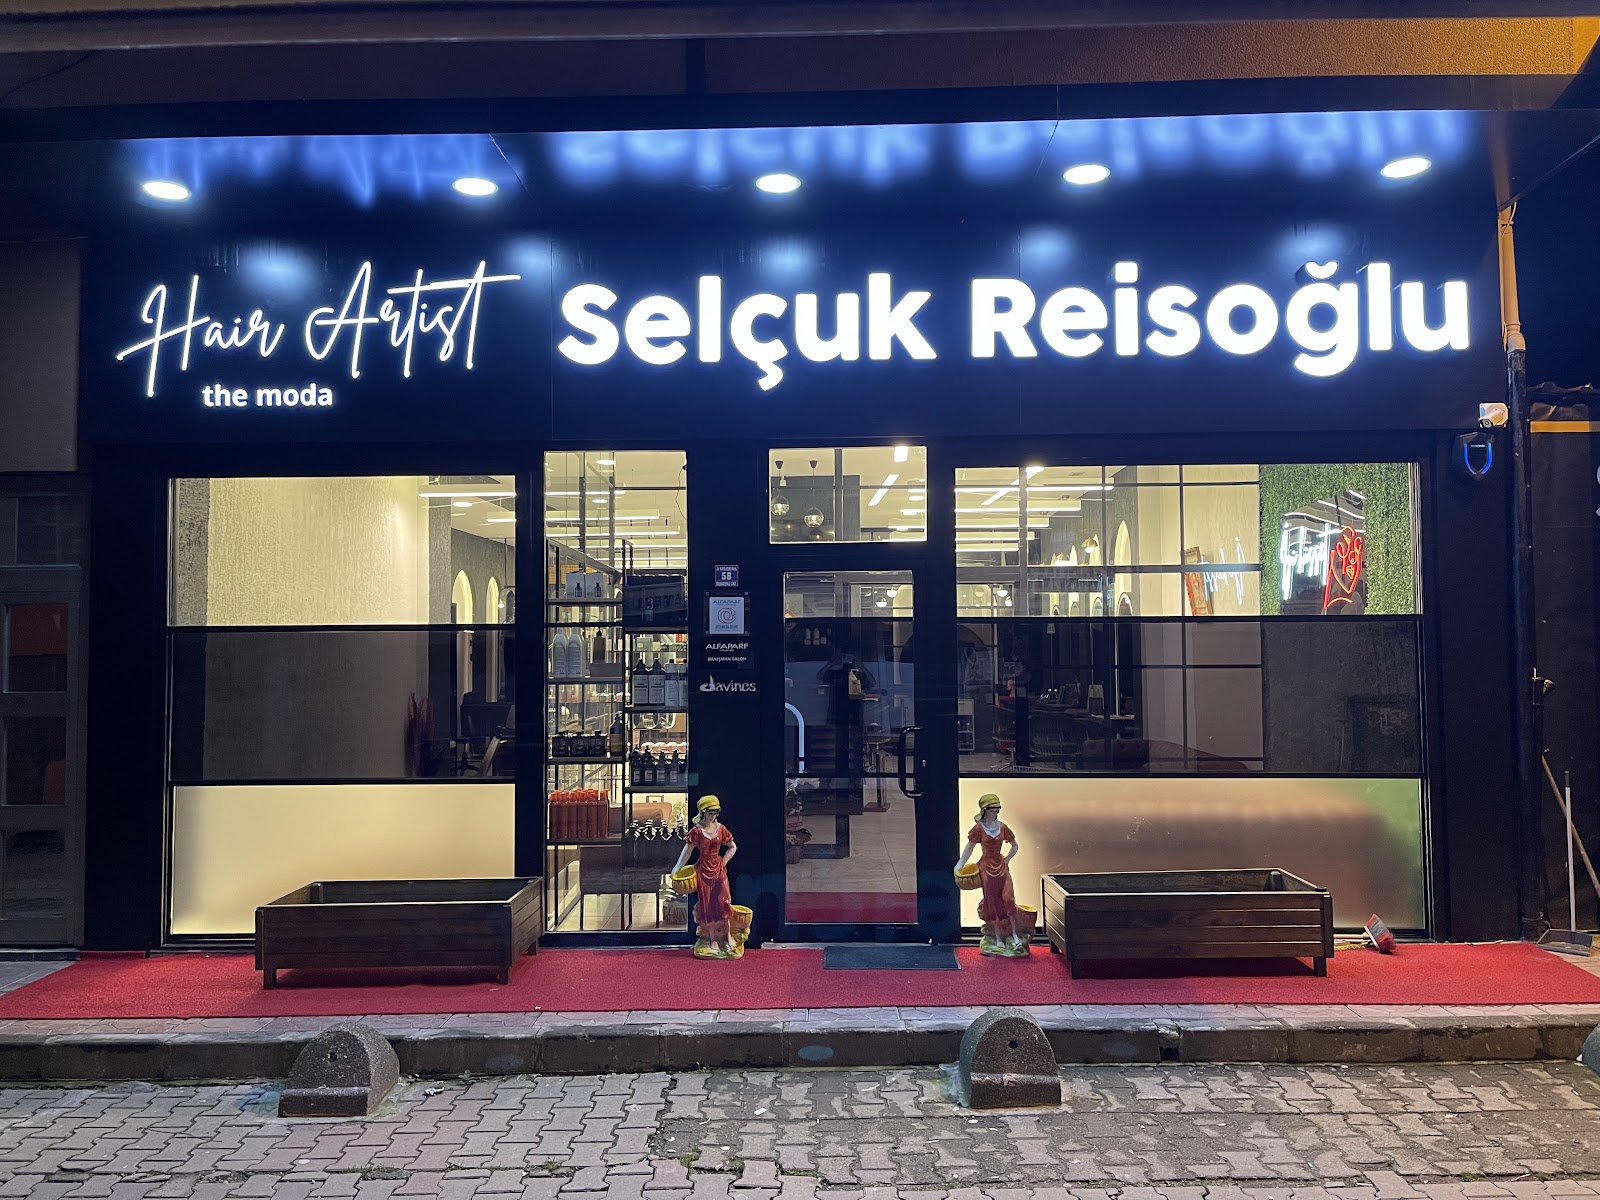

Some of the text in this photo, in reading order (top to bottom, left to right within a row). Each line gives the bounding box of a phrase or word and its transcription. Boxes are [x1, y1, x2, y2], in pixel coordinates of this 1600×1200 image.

[116, 260, 521, 398] Hair Artist
[557, 260, 1471, 391] Selçuk Reisoğlu
[202, 383, 334, 407] the moda
[721, 571, 732, 581] 5B
[705, 642, 749, 650] ALFAPARF
[699, 674, 757, 692] davines
